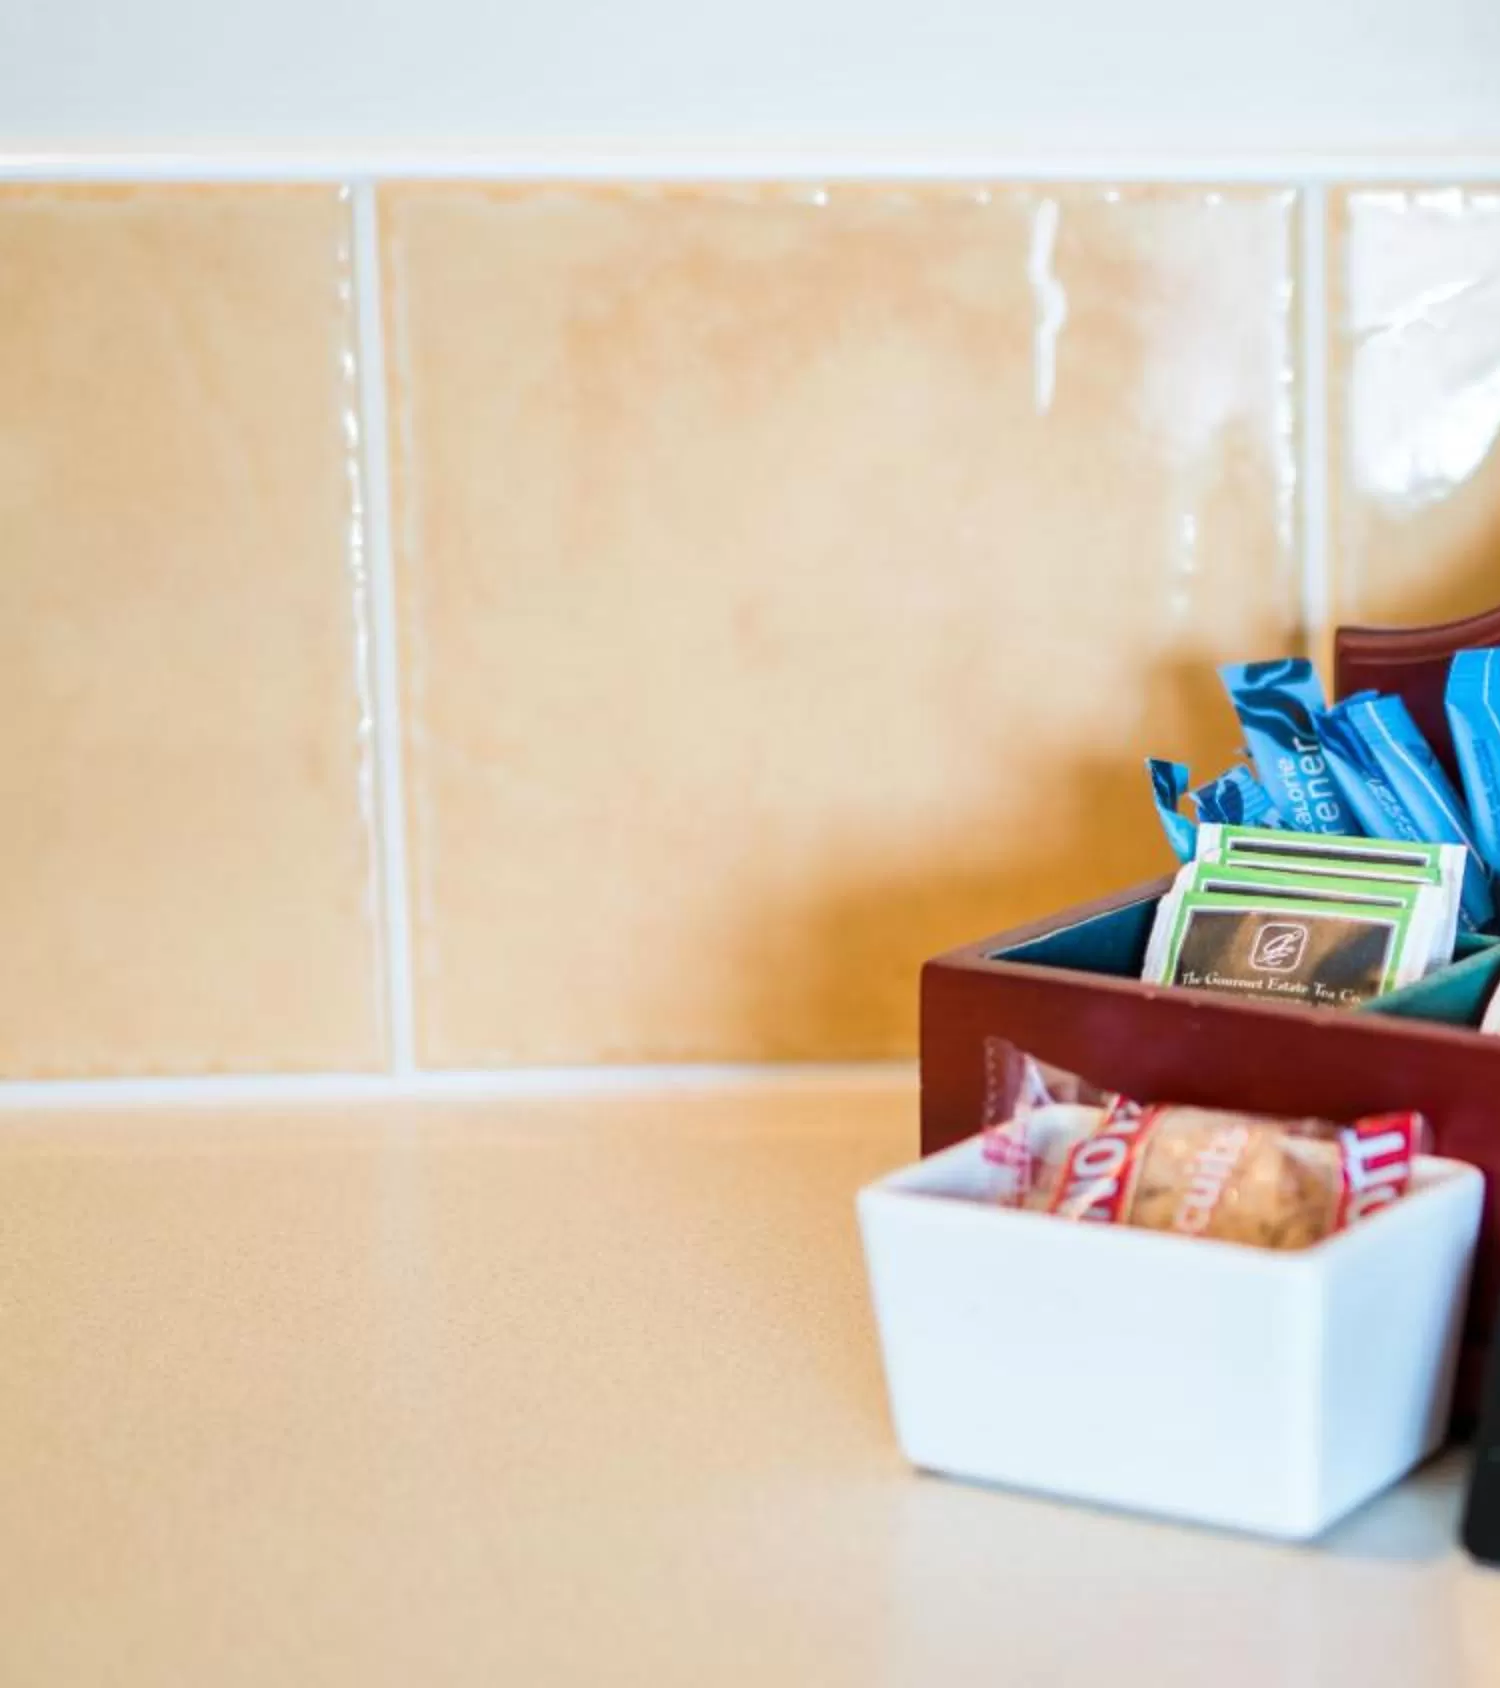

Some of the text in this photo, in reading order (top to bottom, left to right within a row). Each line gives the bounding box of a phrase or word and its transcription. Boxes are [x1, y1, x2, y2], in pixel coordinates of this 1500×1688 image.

[1182, 971, 1201, 986] The
[1203, 972, 1265, 990] Gourmet
[1267, 976, 1310, 995] Estate
[1313, 980, 1337, 1000] Tea
